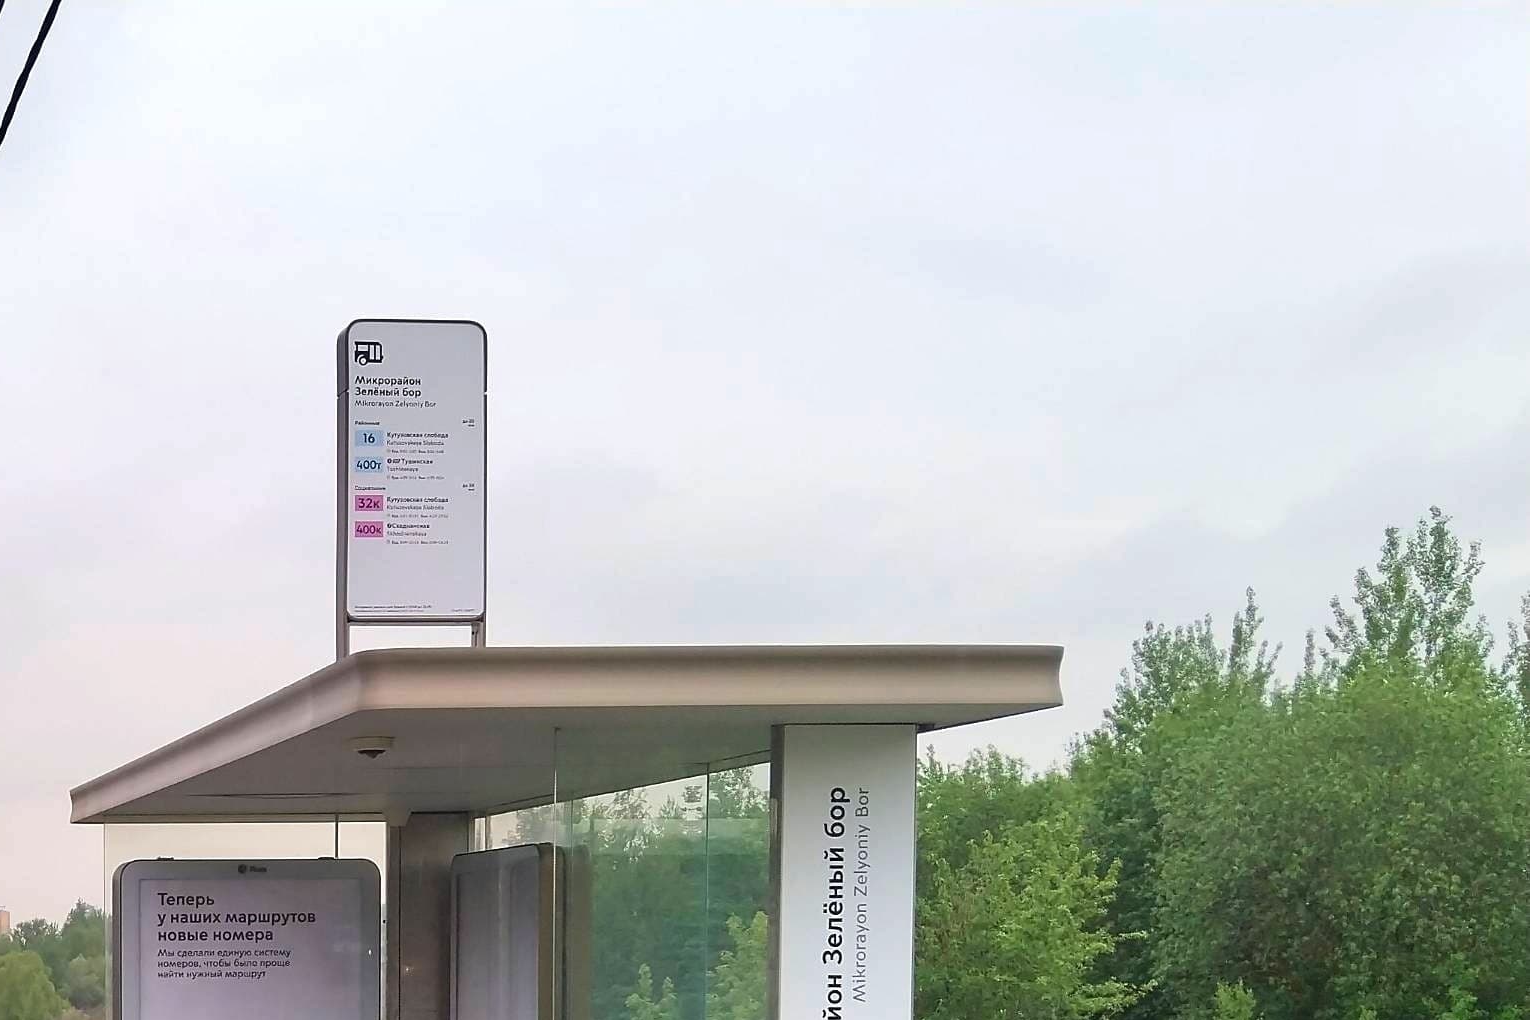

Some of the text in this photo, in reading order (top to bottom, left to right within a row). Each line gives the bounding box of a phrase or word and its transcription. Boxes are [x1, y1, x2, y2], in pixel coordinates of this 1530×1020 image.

[354, 375, 421, 387] Микрорайон
[354, 386, 422, 398] Зелёный бор
[362, 432, 376, 444] 16
[356, 460, 382, 470] 400т
[358, 498, 380, 509] 32к
[356, 525, 382, 535] 400к
[823, 786, 851, 838] бор
[157, 892, 215, 908] Теперь
[852, 786, 871, 1003] Mikrorayon Zelyoniy Bor
[822, 847, 845, 965] Зелёный
[157, 912, 316, 926] у наших маршрутов
[158, 930, 274, 943] новые номера
[157, 949, 291, 958] Мы сделали единую систему
[157, 958, 290, 969] номеров, чтобы было проще
[157, 970, 266, 979] найти нужный маршрут
